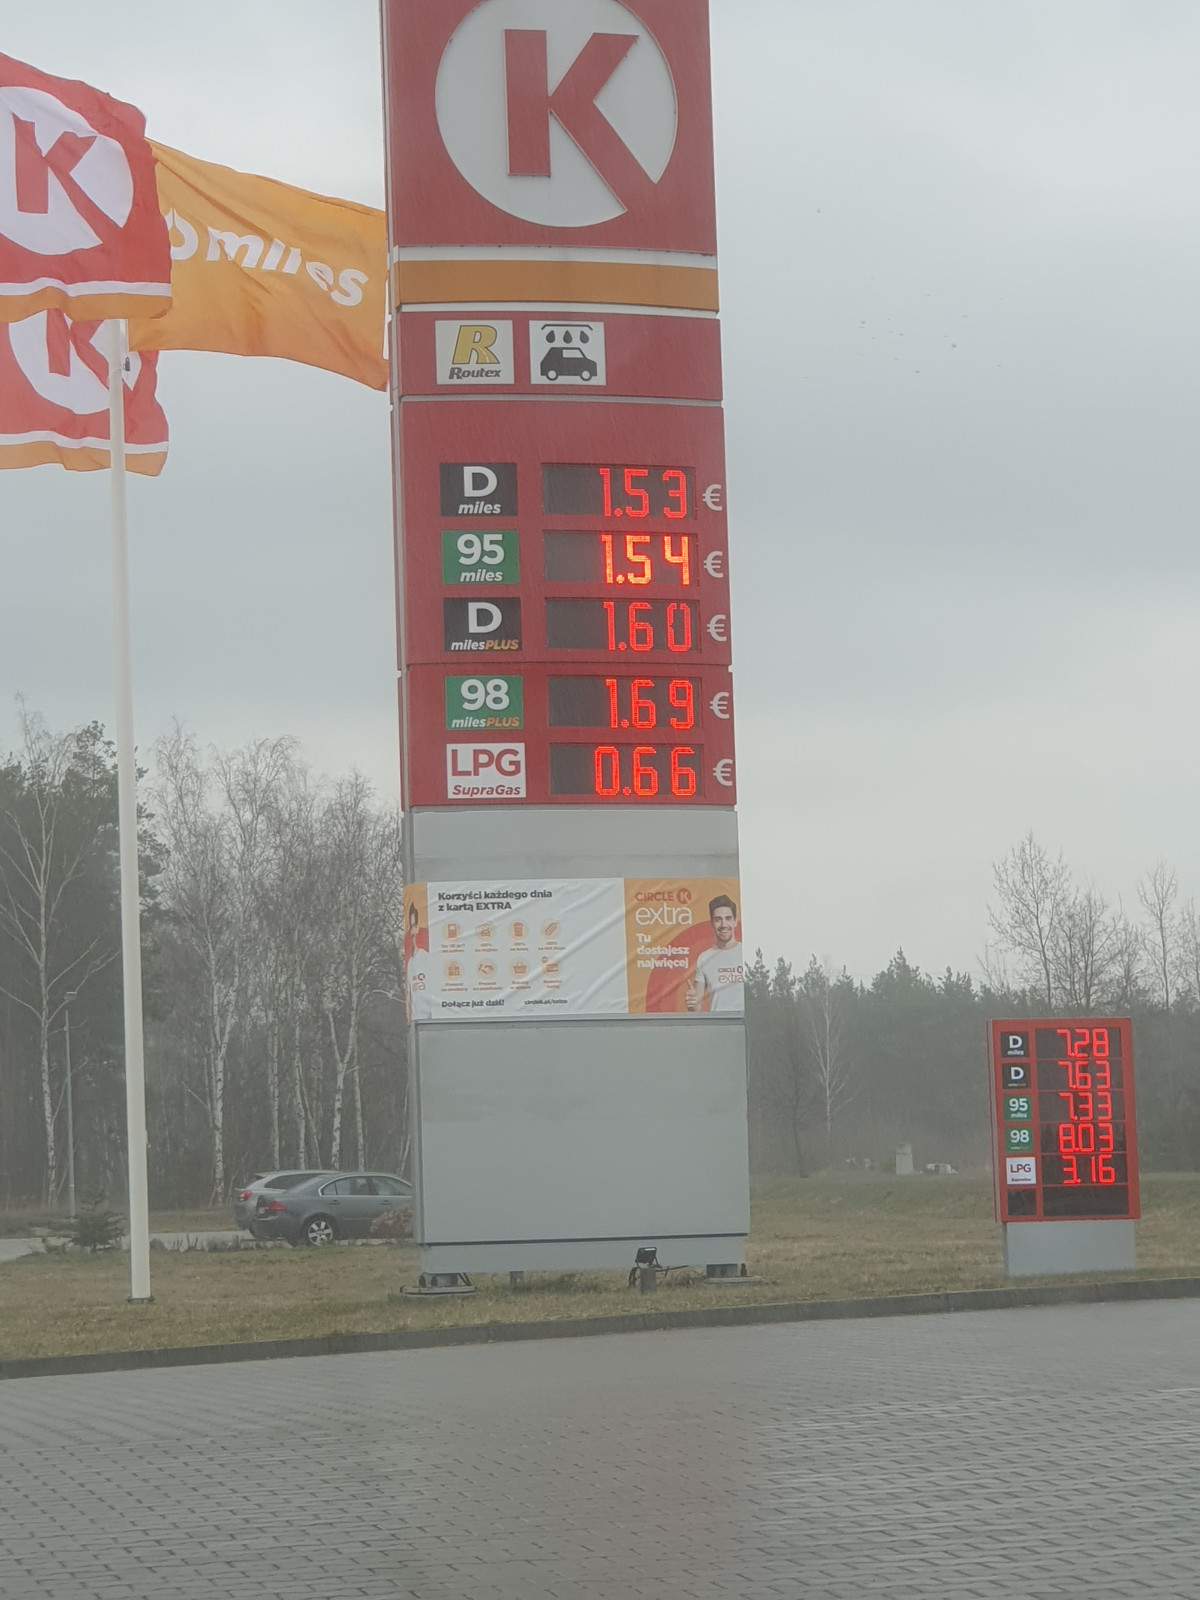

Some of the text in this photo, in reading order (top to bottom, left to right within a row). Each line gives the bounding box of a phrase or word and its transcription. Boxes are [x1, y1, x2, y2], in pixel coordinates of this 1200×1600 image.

[503, 28, 658, 213] K
[12, 112, 124, 247] K
[449, 367, 501, 380] Routex
[463, 466, 498, 497] D
[600, 468, 723, 519] 1.53 €
[458, 501, 502, 514] miles
[457, 533, 505, 565] 95
[601, 534, 724, 586] 1.54 €
[460, 569, 503, 582] miles
[468, 602, 503, 634] D
[603, 602, 727, 652] 1.60 €
[451, 639, 519, 651] milesPLUS
[460, 678, 510, 711] 98
[605, 679, 730, 729] 1.69 €
[451, 717, 520, 728] milesPLUS
[451, 749, 521, 777] LPG
[594, 746, 733, 796] 0.66 €
[452, 784, 521, 797] SupraGas
[437, 889, 553, 901] Korzyści każdego dnia
[635, 891, 674, 902] CIRCLE
[446, 903, 474, 912] kartą
[476, 902, 512, 910] EXTRA
[635, 903, 693, 926] extra
[636, 933, 652, 943] Tu
[637, 945, 690, 957] dostajesz
[637, 957, 689, 969] najwięcej
[441, 1000, 470, 1008] Dołącz
[1009, 1035, 1023, 1048] D
[1010, 1066, 1025, 1080] D
[1009, 1098, 1029, 1112] 95
[1010, 1129, 1030, 1143] 98
[1010, 1163, 1032, 1174] LPG
